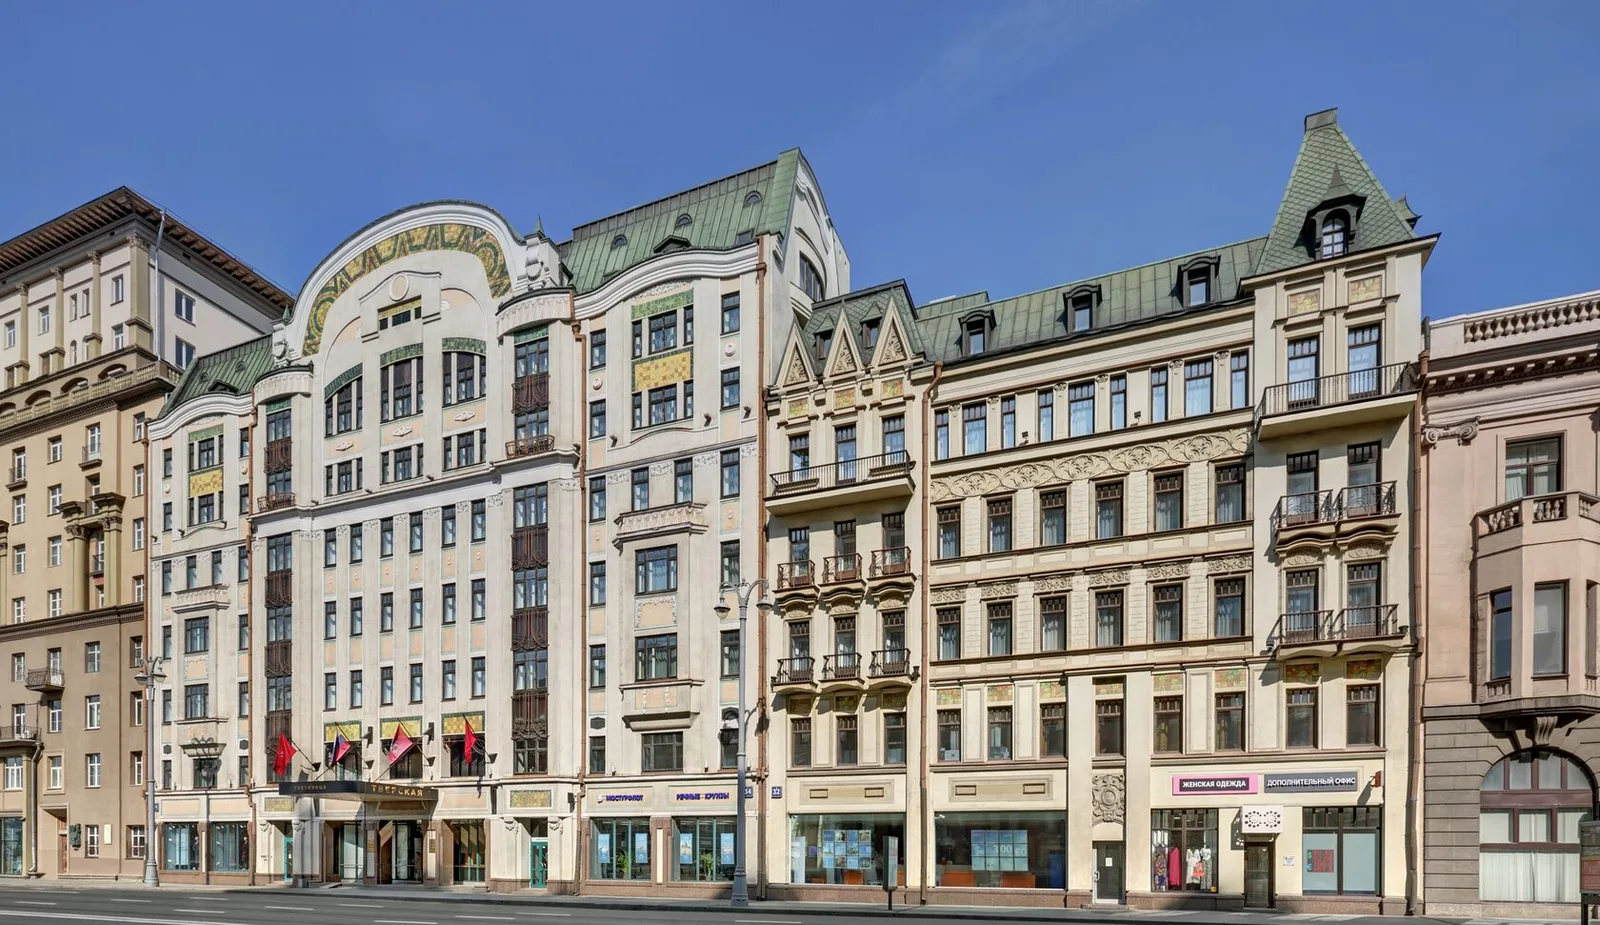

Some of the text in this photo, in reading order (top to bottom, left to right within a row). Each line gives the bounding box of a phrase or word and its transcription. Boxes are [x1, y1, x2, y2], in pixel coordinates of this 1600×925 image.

[1215, 780, 1246, 788] ОДЕЖДА
[1266, 776, 1356, 787] ДОПОЛНИТЕЛЬНЫЙ ОФИС
[371, 784, 423, 797] ТВЕРСКАЯ
